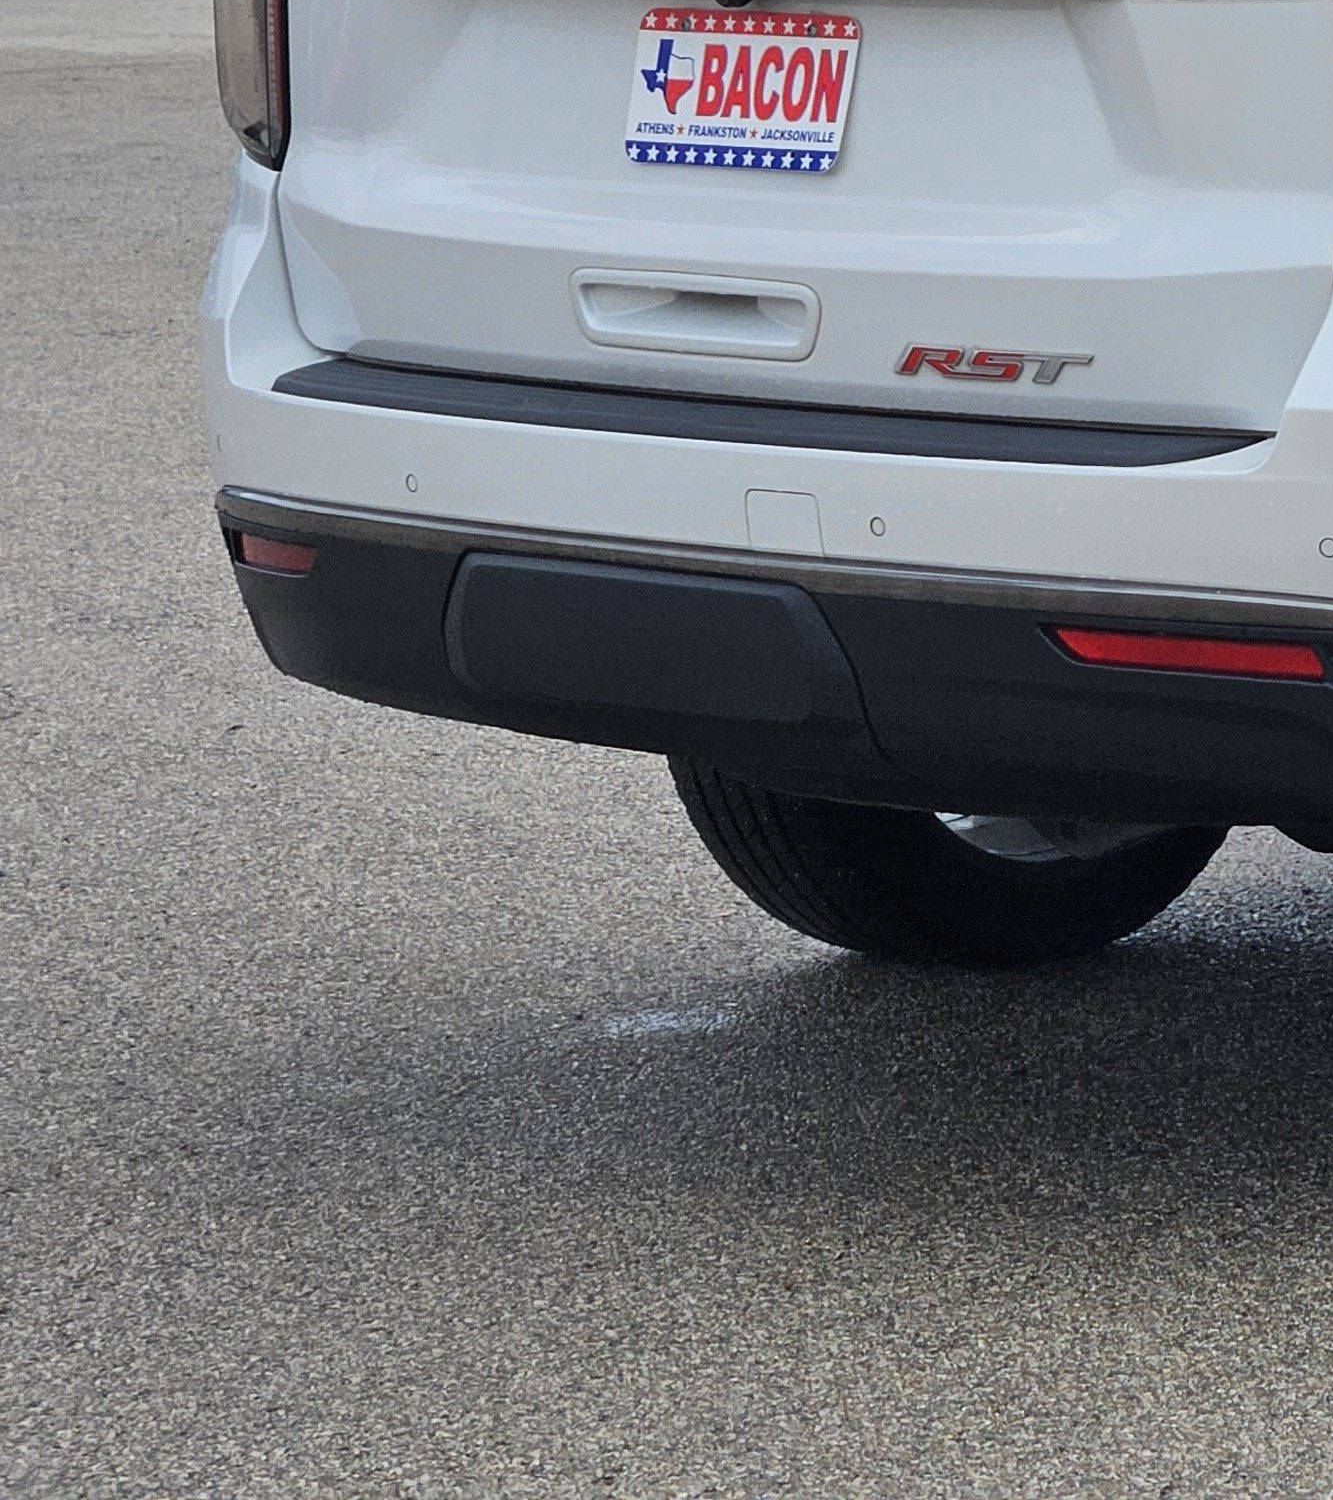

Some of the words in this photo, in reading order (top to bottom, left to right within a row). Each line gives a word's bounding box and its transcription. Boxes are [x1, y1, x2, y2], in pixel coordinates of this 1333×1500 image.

[695, 43, 850, 124] BACON
[635, 121, 675, 136] ATHENS
[686, 123, 748, 140] FRANKSTON
[760, 127, 836, 144] JACKSONVILLE
[893, 341, 1096, 385] RST
